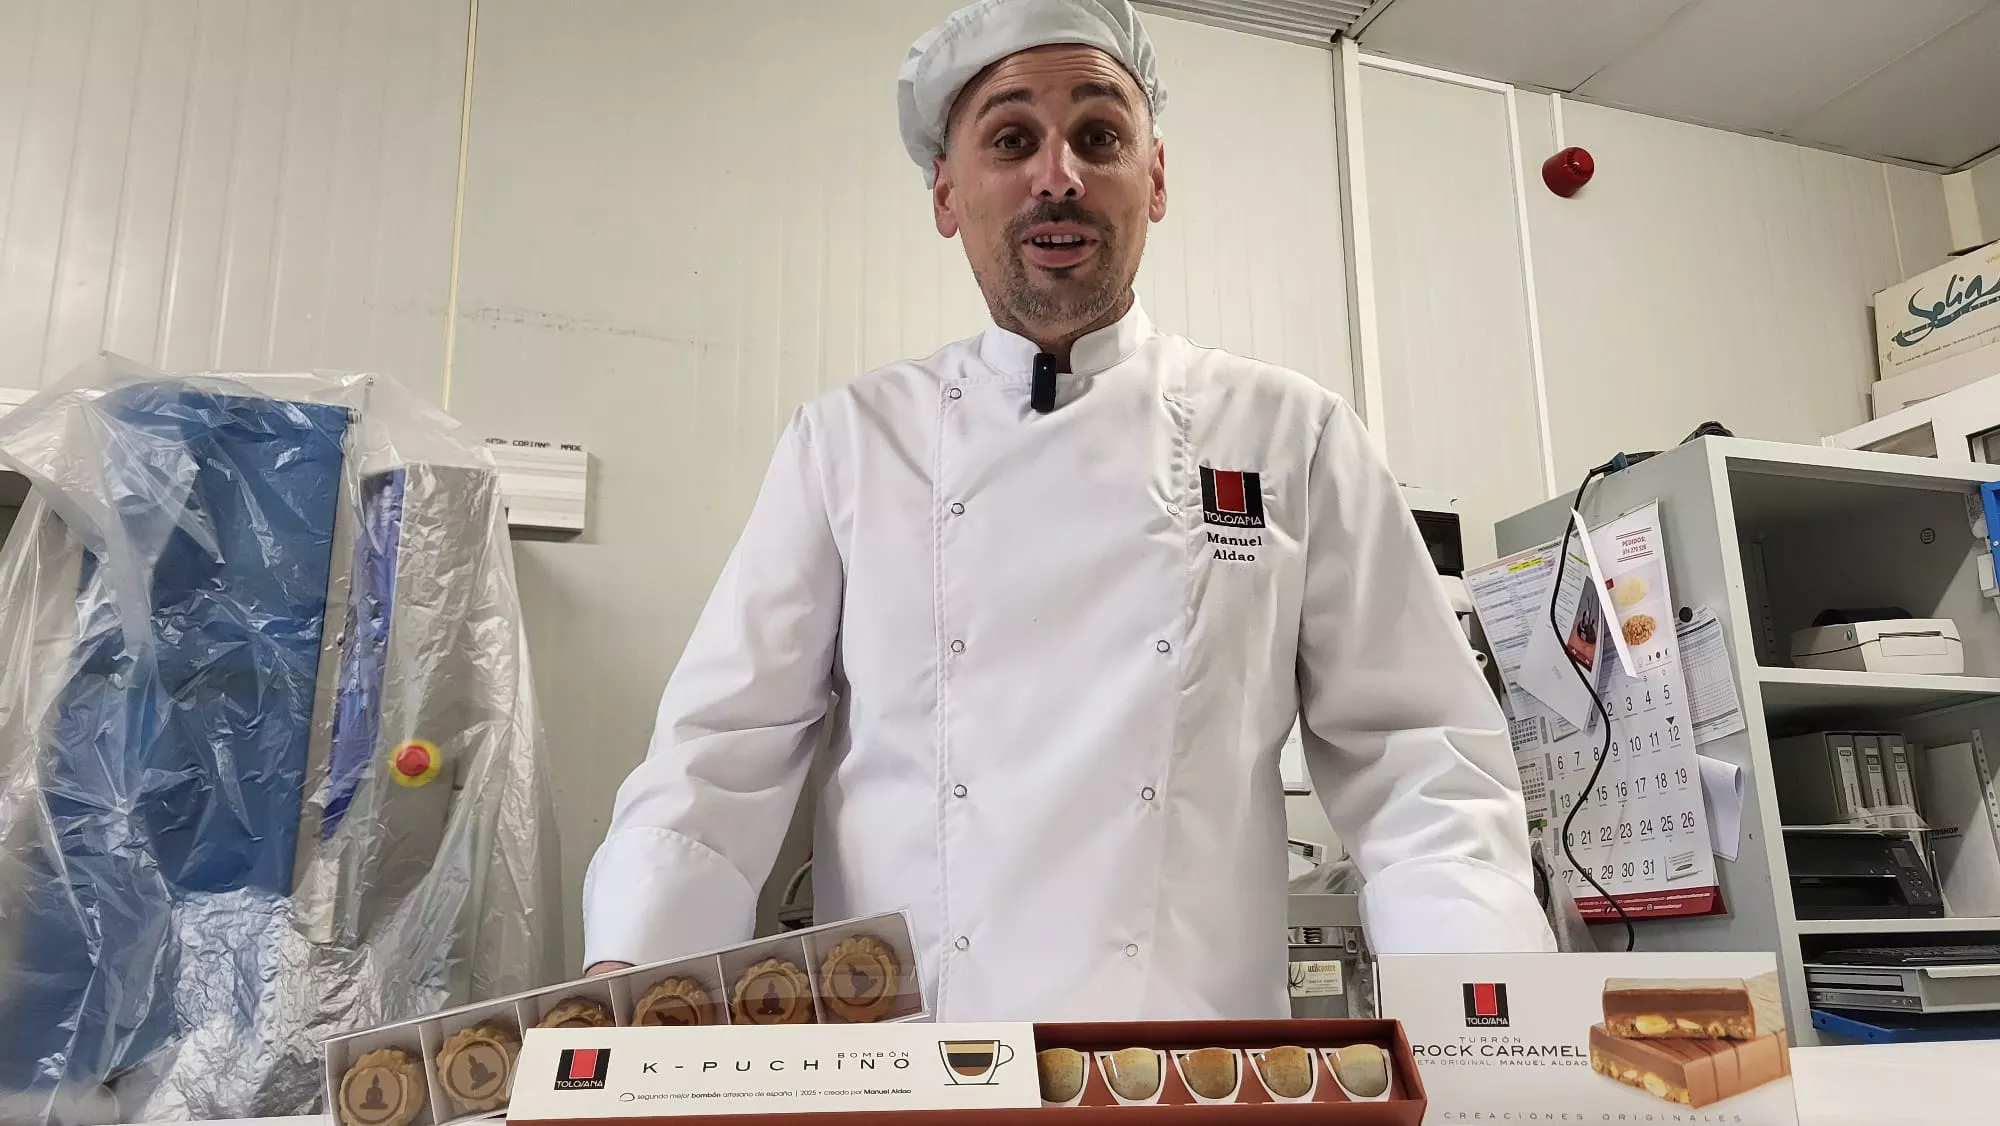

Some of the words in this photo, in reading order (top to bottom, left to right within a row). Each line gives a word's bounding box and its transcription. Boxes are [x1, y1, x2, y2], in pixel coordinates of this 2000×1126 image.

[1204, 510, 1262, 526] TOLOSANA
[1206, 531, 1262, 547] Manuel
[1213, 549, 1256, 562] Aldao
[1606, 702, 1614, 717] 2
[1625, 696, 1633, 711] 3
[1645, 690, 1652, 705] 4
[1663, 684, 1670, 700] 5
[1557, 755, 1564, 770] 6
[1574, 751, 1580, 766] 7
[1593, 747, 1600, 761] 8
[1612, 742, 1619, 757] 9
[1629, 736, 1642, 753] 10
[1649, 731, 1660, 747] 11
[1667, 725, 1681, 742] 12
[1560, 793, 1571, 809] 13
[1596, 786, 1608, 801] 15
[1616, 781, 1628, 798] 16
[1635, 777, 1647, 793] 17
[1655, 772, 1668, 789] 18
[1675, 768, 1688, 784] 19
[1581, 830, 1592, 845] 21
[1600, 826, 1613, 842] 22
[1620, 822, 1633, 839] 23
[1640, 819, 1653, 836] 24
[1660, 815, 1674, 832] 25
[1680, 811, 1695, 829] 26
[1601, 864, 1614, 880] 29
[1621, 862, 1635, 878] 30
[1642, 859, 1655, 875] 31
[1466, 1017, 1509, 1025] TOLOSANA
[1459, 1036, 1522, 1044] TURRÓN
[837, 1050, 909, 1058] BOMBÓN
[1412, 1044, 1474, 1057] ROCK
[1480, 1045, 1588, 1058] CARAMEL
[1417, 1059, 1437, 1067] ETA
[1500, 1059, 1546, 1067] MANUEL
[556, 1080, 604, 1089] TOLOSANA
[637, 1093, 669, 1101] segundo
[669, 1092, 690, 1100] mejor
[691, 1090, 721, 1099] bombón
[722, 1090, 753, 1098] artesano
[754, 1090, 765, 1098] de
[766, 1090, 793, 1098] españa
[850, 1089, 863, 1097] por
[863, 1088, 890, 1096] Manuel
[890, 1087, 912, 1095] Aldao
[1443, 1112, 1585, 1122] CREACIONES
[1602, 1113, 1743, 1123] ORIGINALES
